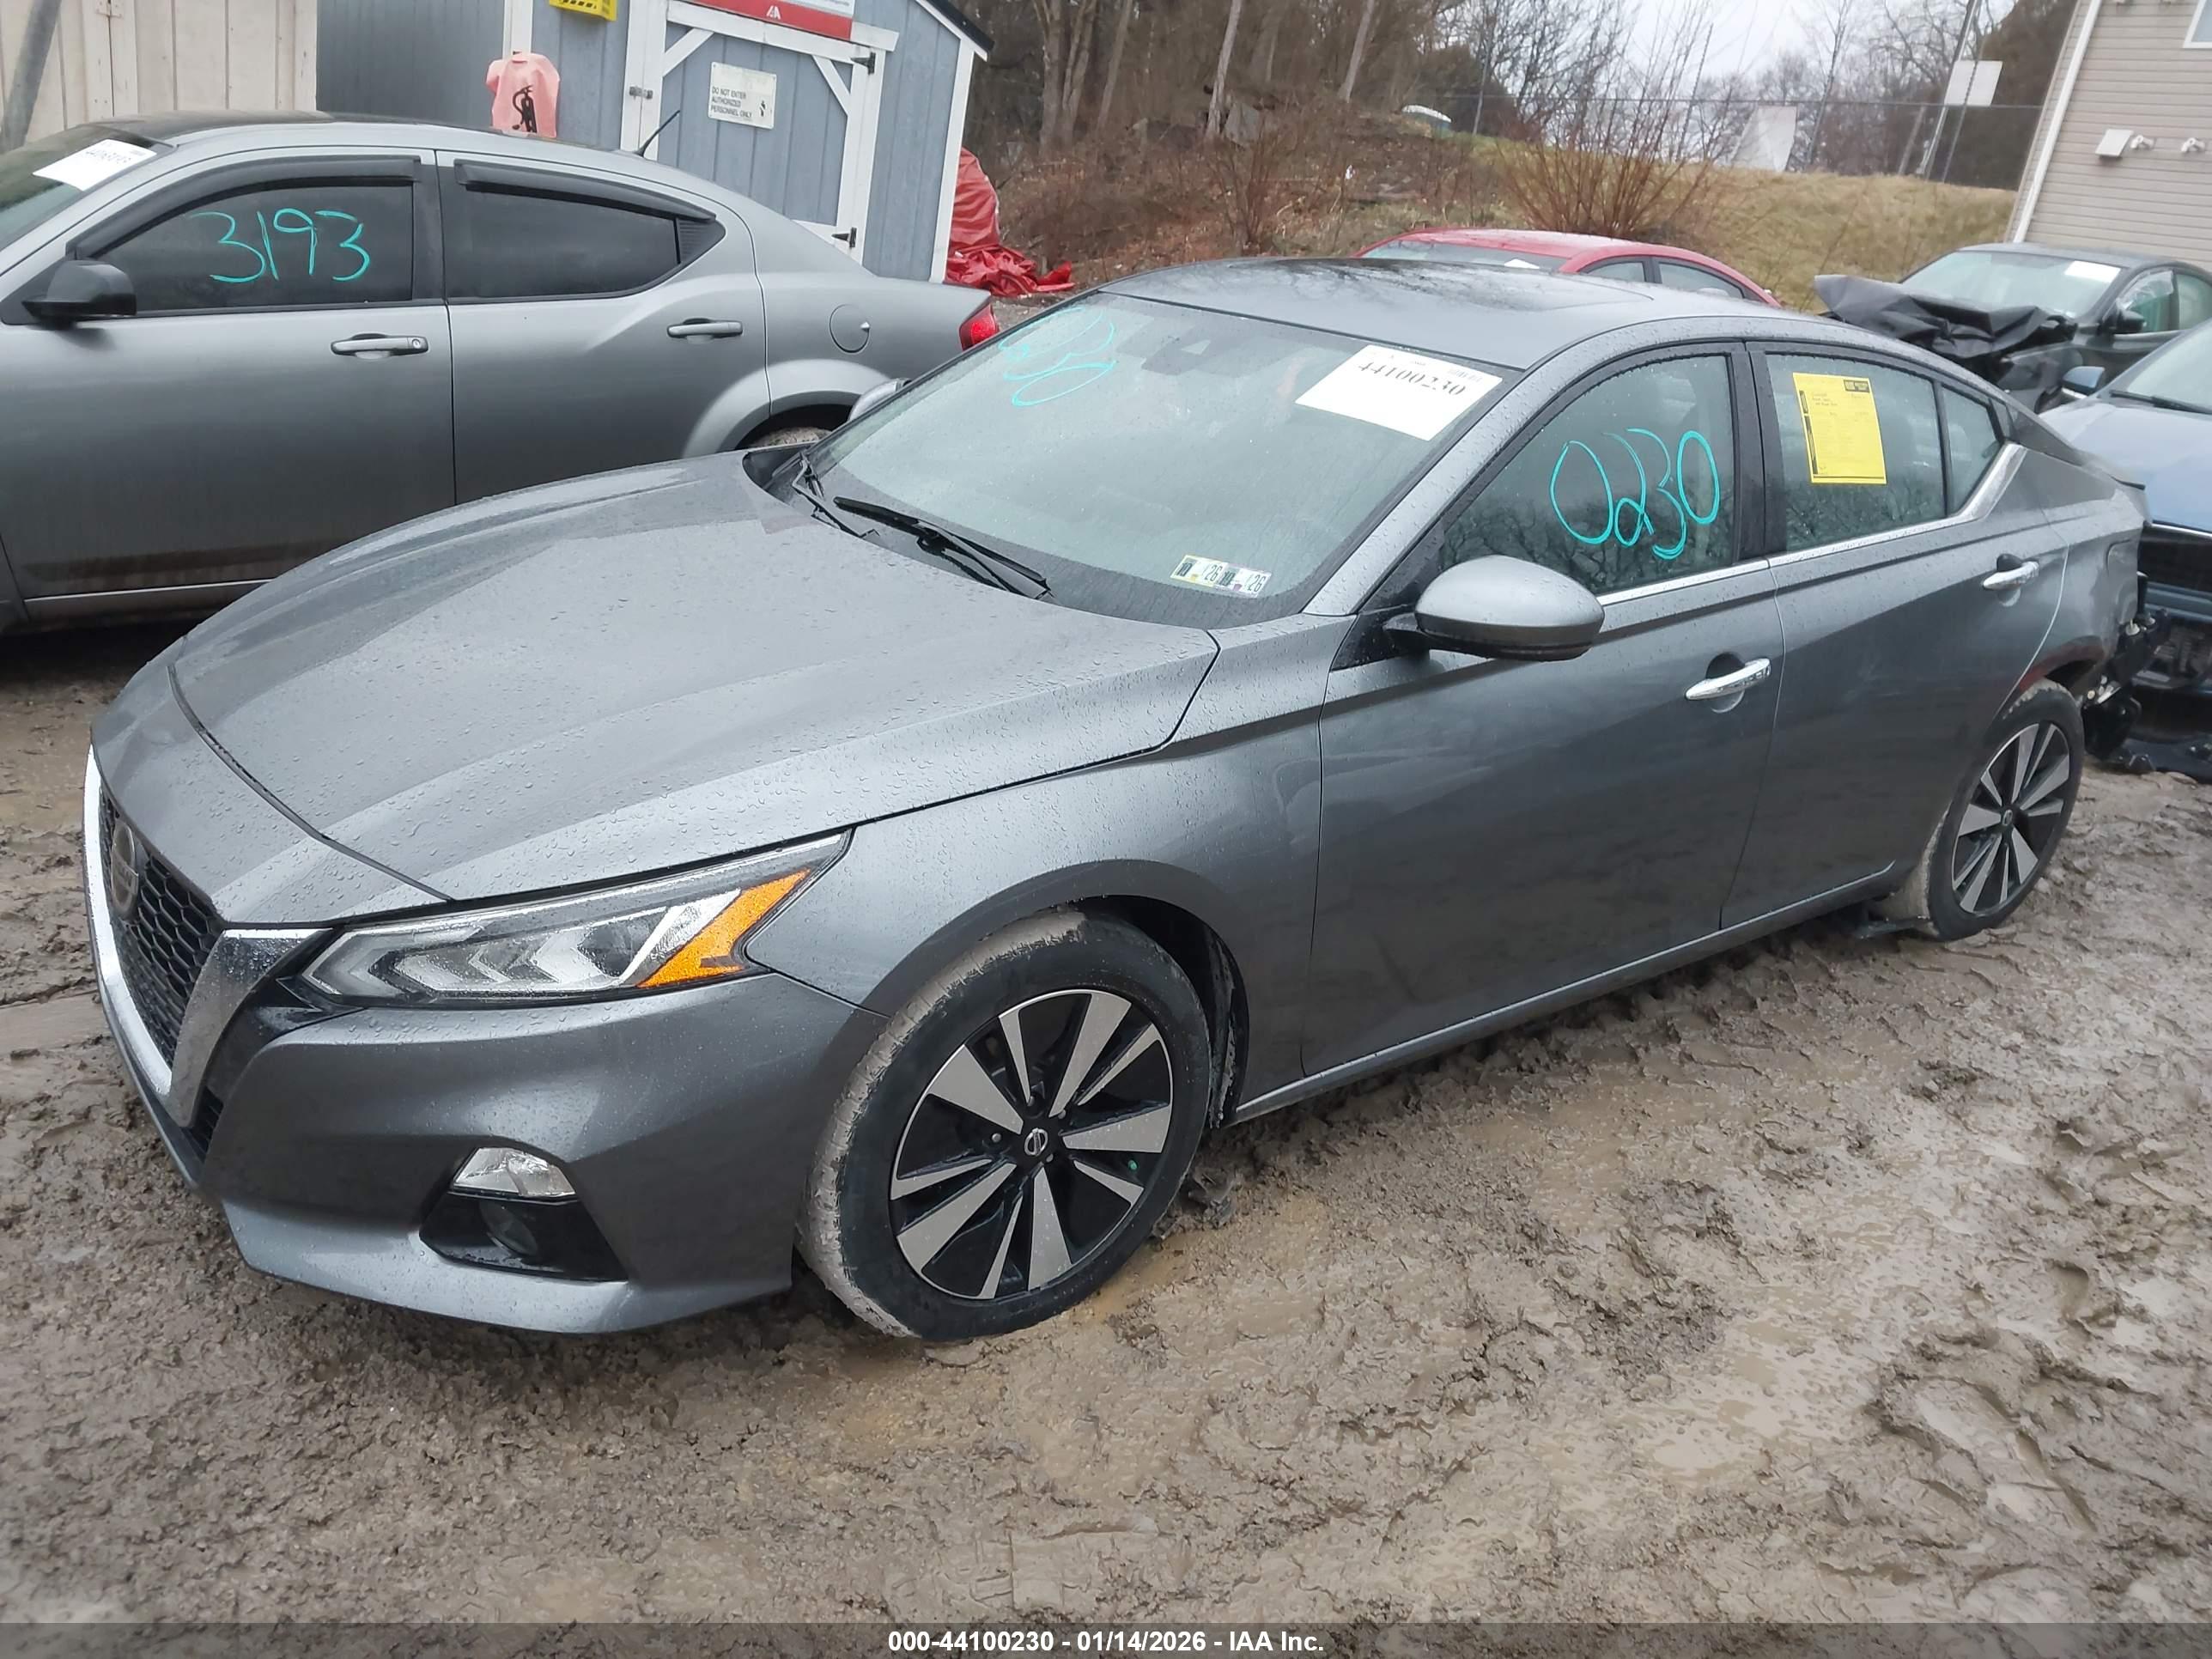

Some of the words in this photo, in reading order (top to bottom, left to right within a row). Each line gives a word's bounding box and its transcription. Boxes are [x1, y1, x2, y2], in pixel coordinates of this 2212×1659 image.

[712, 86, 720, 94] DO
[720, 88, 730, 97] NOT
[731, 90, 747, 100] ENTER
[710, 105, 738, 117] PERSONNEL
[739, 110, 752, 118] ONLY
[186, 208, 370, 283] 3193
[1358, 361, 1468, 397] 44100230
[1549, 427, 1721, 561] 0230
[1204, 564, 1224, 582] 26
[1247, 574, 1267, 592] 26
